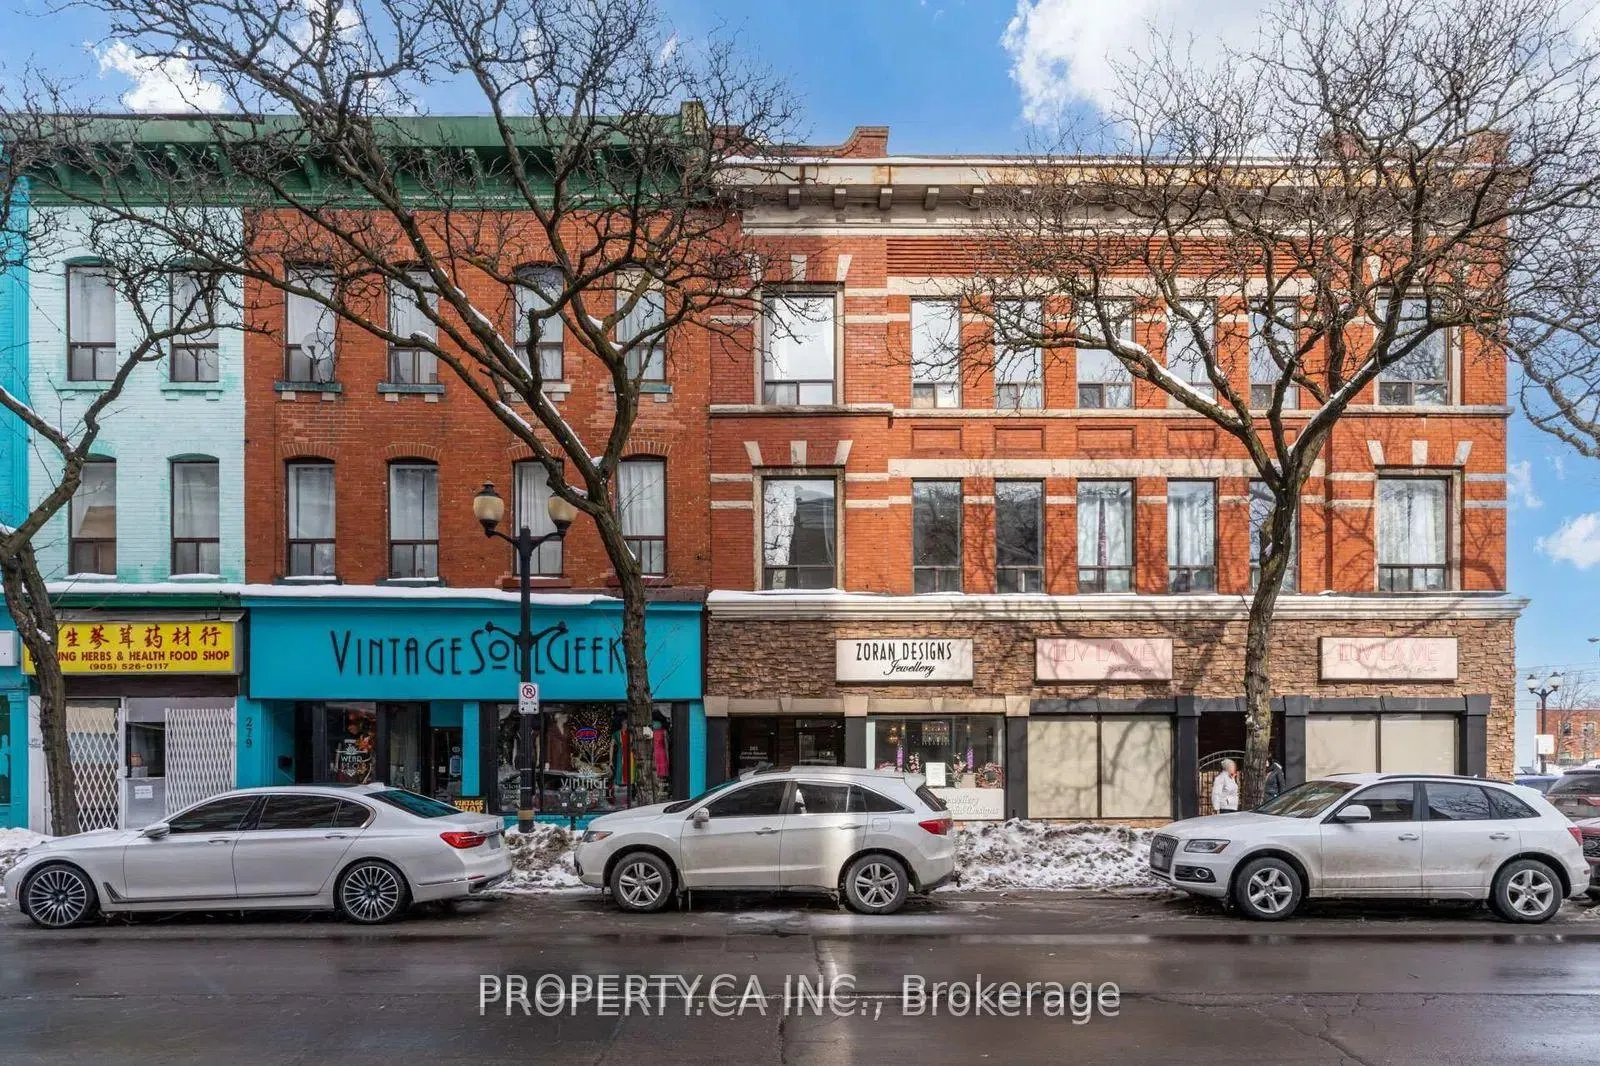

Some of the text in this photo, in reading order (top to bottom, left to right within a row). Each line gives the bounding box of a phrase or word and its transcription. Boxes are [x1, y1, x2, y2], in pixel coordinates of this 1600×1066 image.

[82, 651, 111, 661] HERBS
[117, 651, 123, 661] &
[129, 651, 165, 661] HEALTH
[170, 651, 198, 661] FOOD
[203, 650, 230, 661] SHOP
[856, 642, 952, 660] ZORAN DESIGNS
[90, 663, 169, 671] (905) 526-0117
[883, 660, 935, 678] Jewellery
[245, 716, 253, 749] 279
